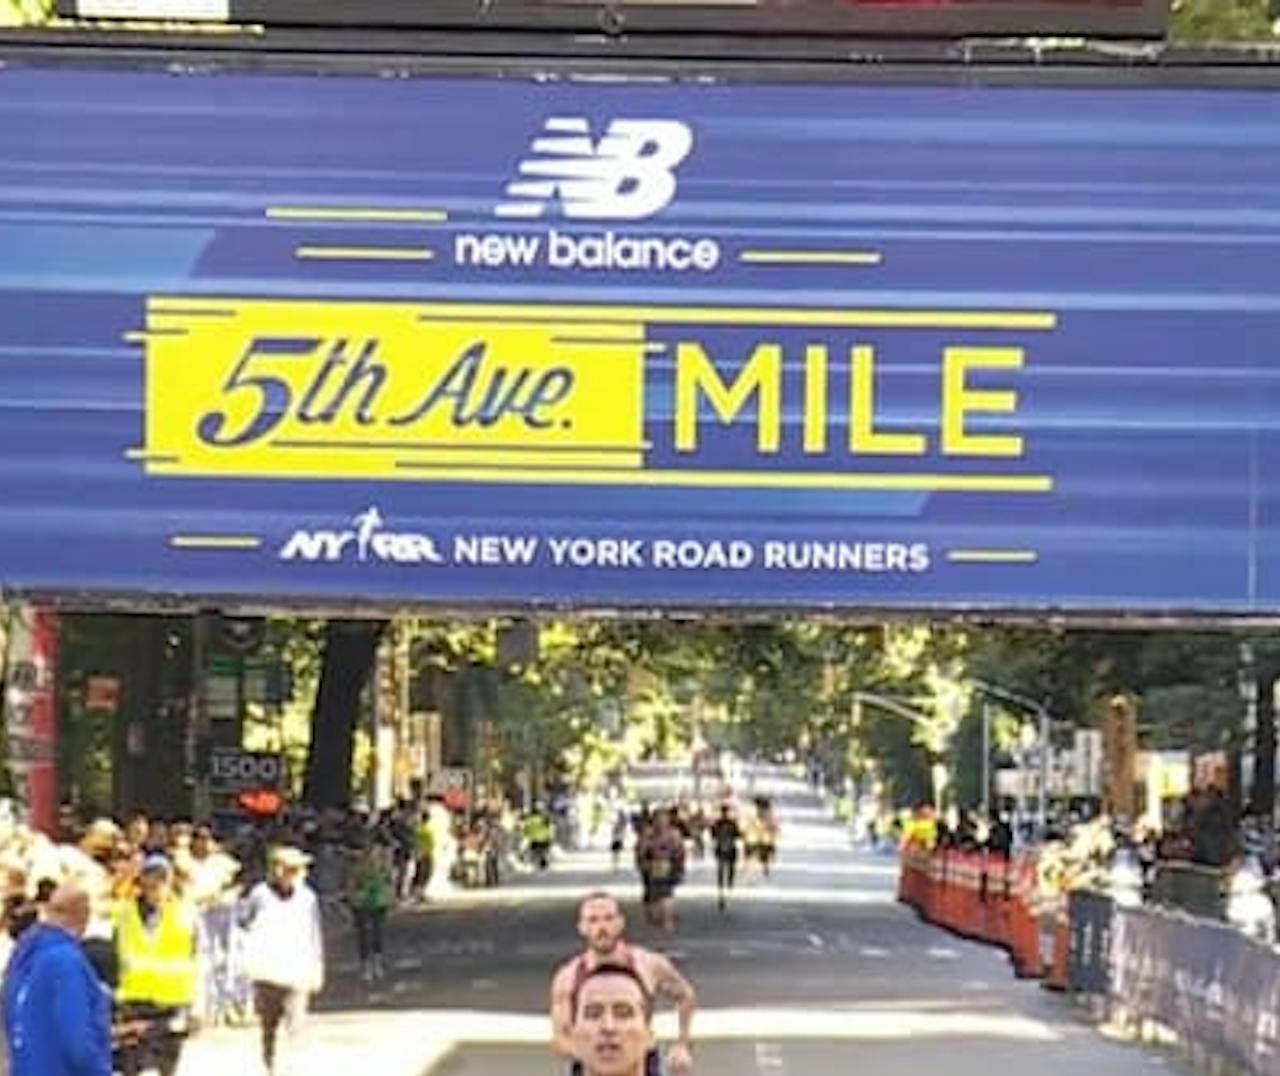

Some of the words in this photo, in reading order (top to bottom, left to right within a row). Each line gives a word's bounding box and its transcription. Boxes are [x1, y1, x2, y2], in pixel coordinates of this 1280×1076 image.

[494, 118, 693, 218] NB
[455, 235, 539, 266] new
[548, 228, 719, 270] balance
[196, 336, 387, 447] 5th
[388, 340, 574, 430] Ave.
[674, 344, 1024, 457] MILE
[454, 535, 537, 563] NEW
[549, 538, 643, 566] YORK
[653, 540, 754, 569] ROAD
[764, 541, 930, 572] RUNNERS
[211, 755, 278, 780] 1500
